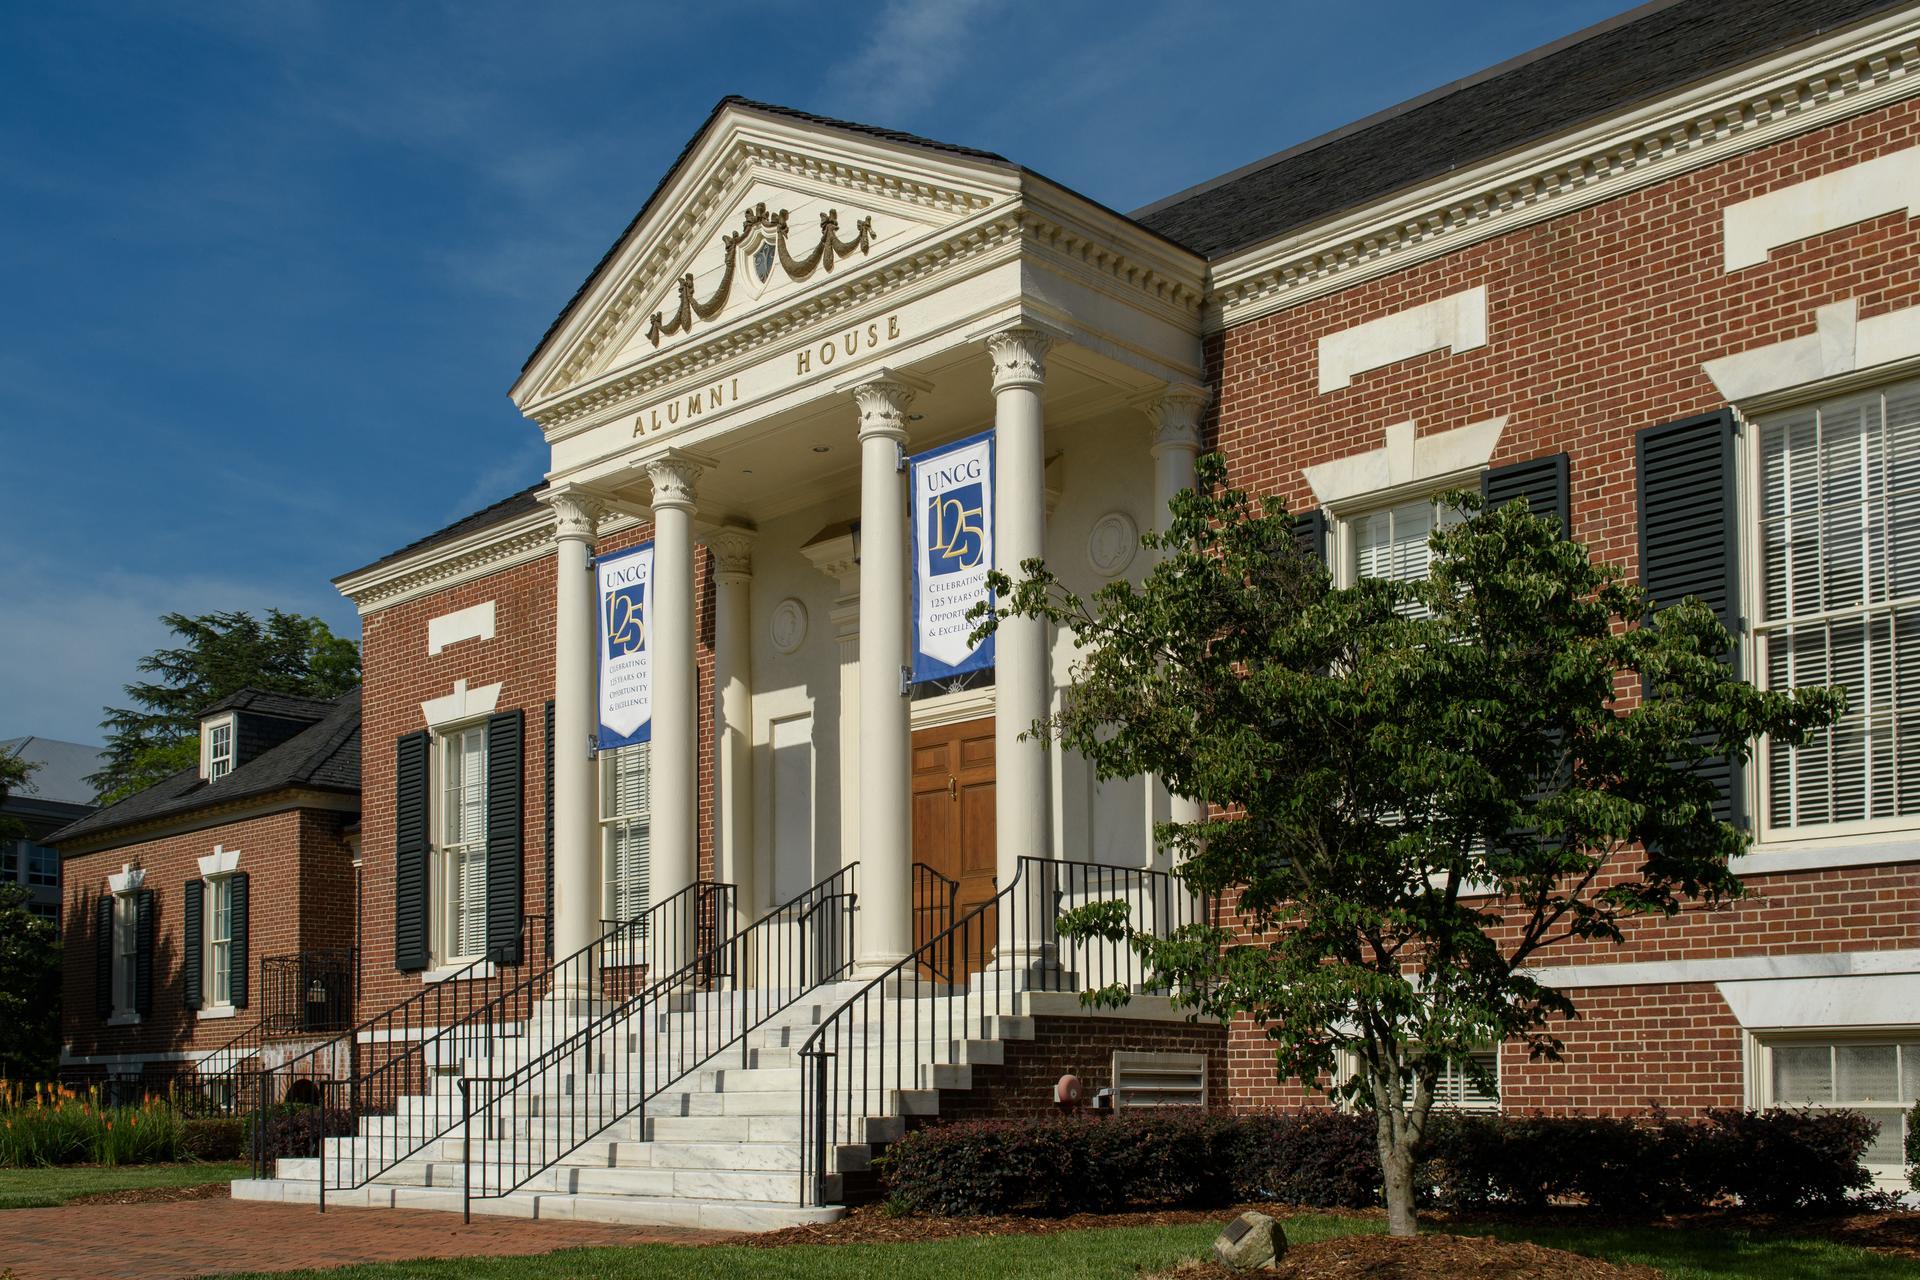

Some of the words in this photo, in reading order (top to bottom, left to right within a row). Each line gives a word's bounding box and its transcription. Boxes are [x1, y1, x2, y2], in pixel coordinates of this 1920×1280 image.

[632, 378, 738, 438] ALUMNI
[797, 315, 900, 375] HOUSE
[928, 459, 982, 492] UNCG
[929, 495, 985, 570] 125
[607, 563, 646, 588] UNCG
[929, 573, 984, 593] CELEBRATING
[931, 597, 945, 608] 125
[948, 591, 972, 604] YEARS
[974, 588, 985, 598] OF
[606, 591, 645, 656] 125
[930, 605, 976, 622] OPPORTU
[929, 627, 936, 637] &
[636, 671, 647, 679] OF
[608, 703, 614, 712] &
